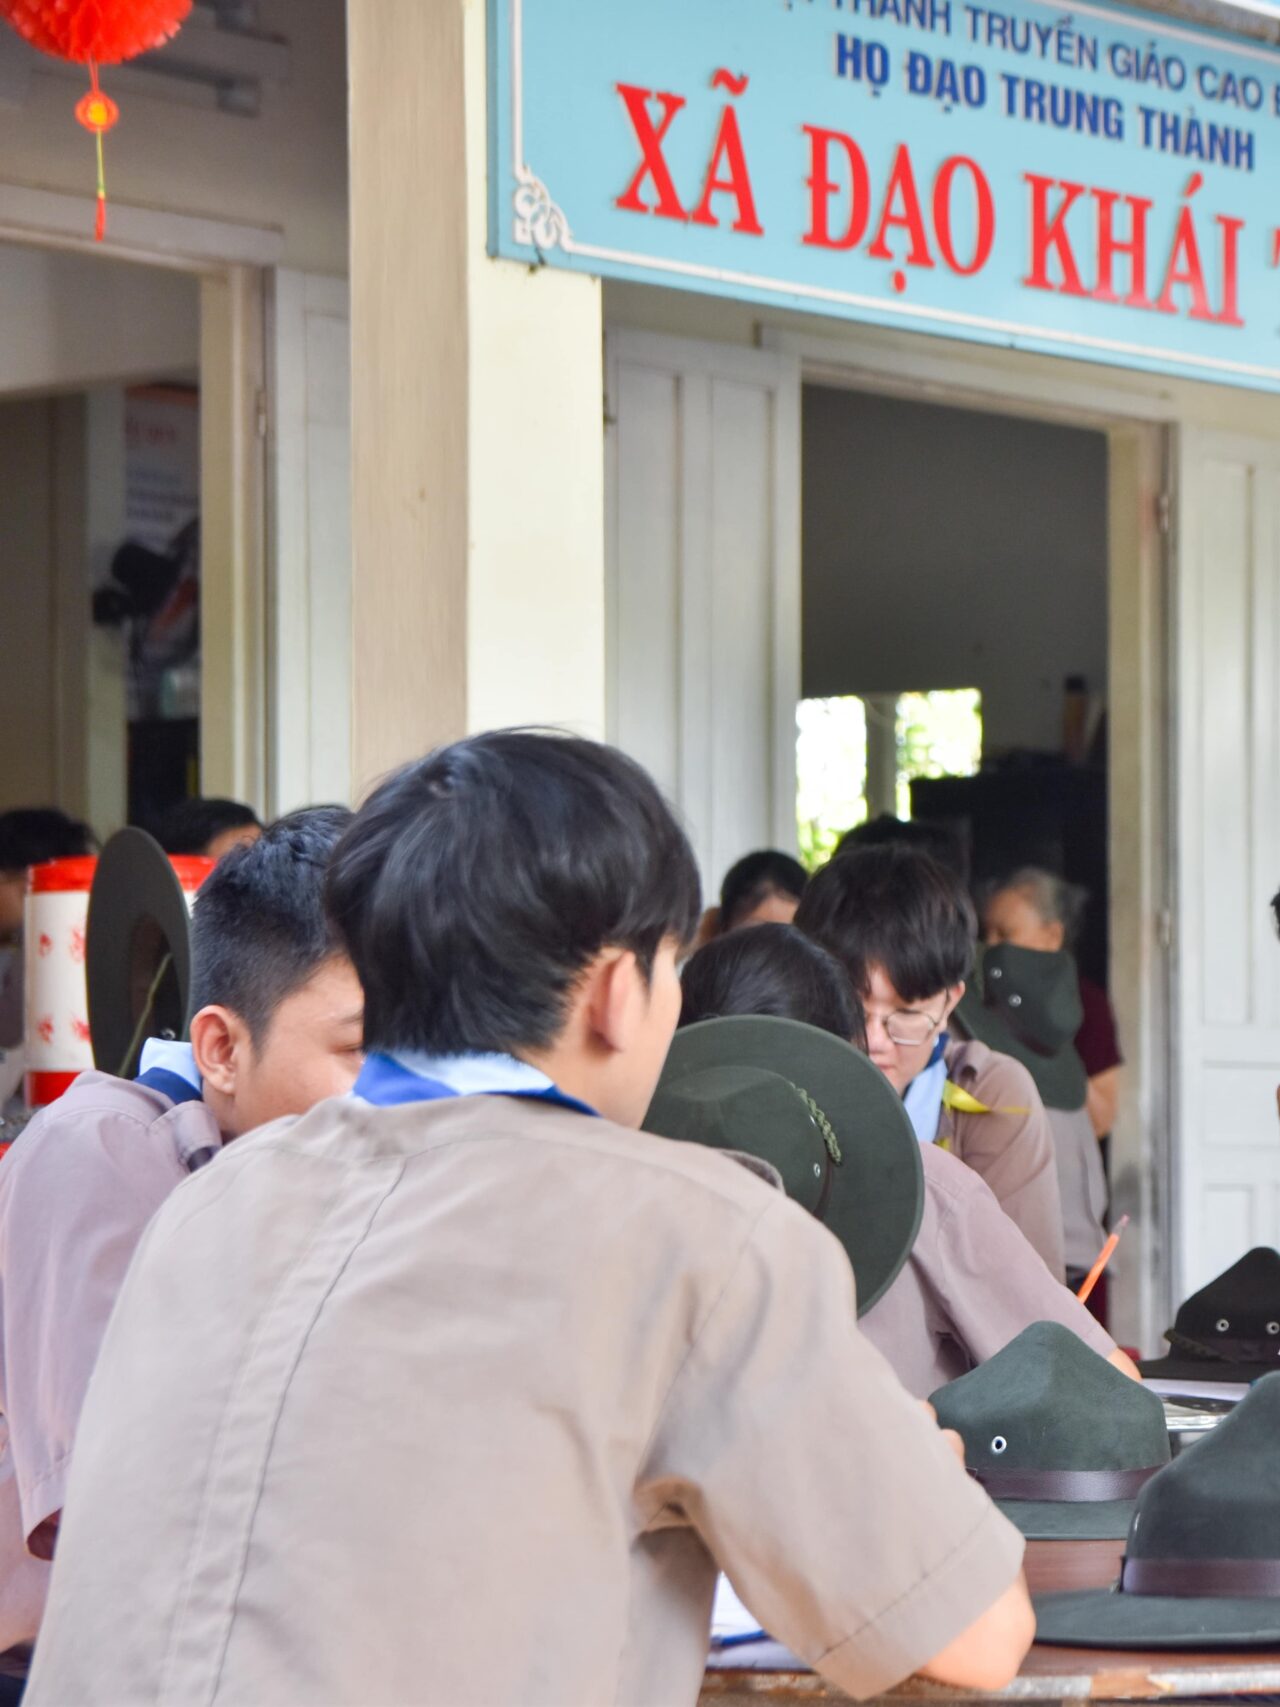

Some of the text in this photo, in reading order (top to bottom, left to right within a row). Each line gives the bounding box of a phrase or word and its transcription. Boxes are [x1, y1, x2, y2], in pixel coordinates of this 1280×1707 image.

[835, 32, 1255, 171] HỌ ĐẠO TRUNG THÀNH
[1108, 42, 1187, 92] GIÁO
[1198, 64, 1264, 111] CAO
[613, 68, 763, 236] XÃ
[801, 124, 996, 293] ĐẠO
[1022, 173, 1245, 327] KHÁI
